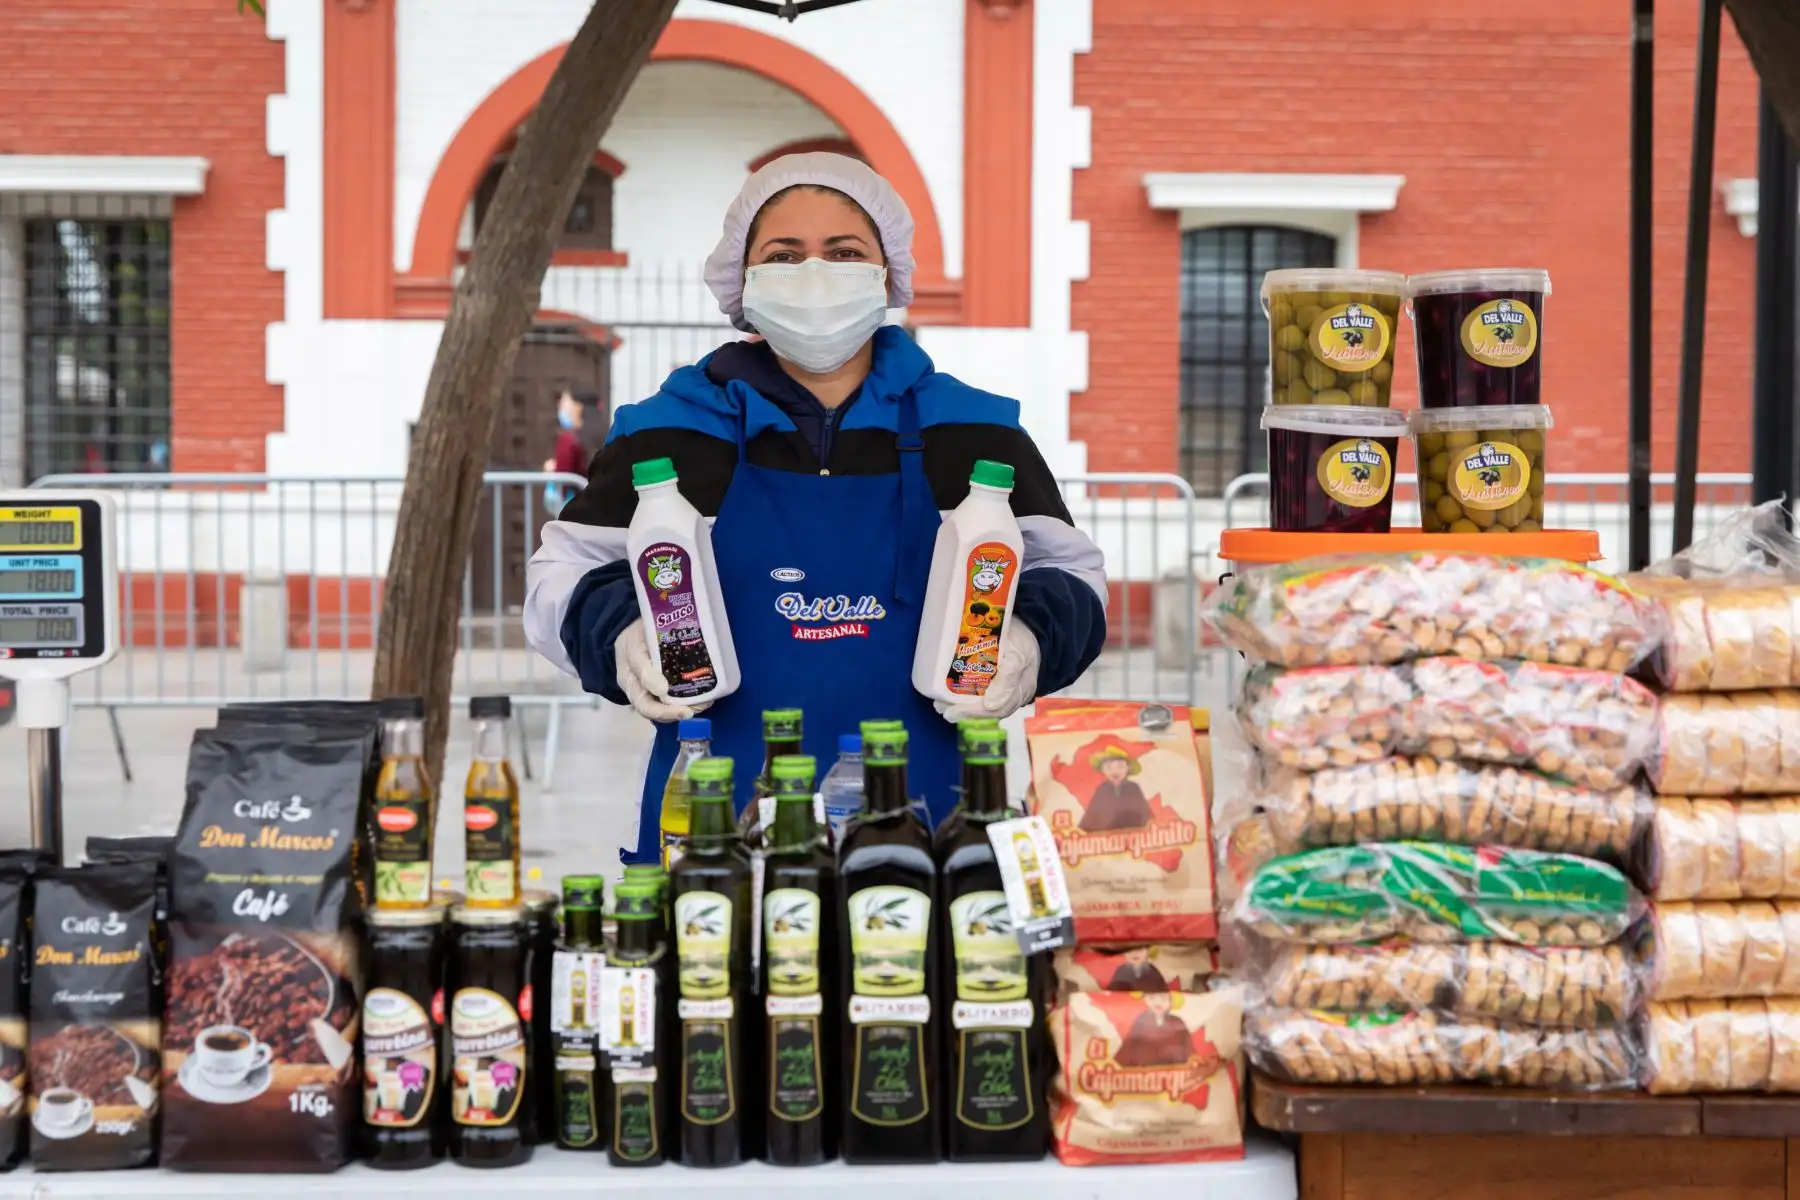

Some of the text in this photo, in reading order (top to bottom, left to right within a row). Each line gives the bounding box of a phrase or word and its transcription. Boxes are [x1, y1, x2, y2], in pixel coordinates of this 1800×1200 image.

[1332, 317, 1374, 329] DEL VALLE
[1483, 312, 1524, 324] DEL VALLE
[1342, 452, 1381, 465] DEL VALLE
[1466, 455, 1510, 470] DEL VALLE
[13, 510, 52, 518] WEIGHT
[9, 559, 60, 567] UNIT PRICE
[2, 606, 70, 616] TOTAL PRICE
[775, 592, 886, 621] Del Valle
[657, 604, 694, 628] Sauco
[794, 623, 865, 640] ARTESANAL
[233, 799, 281, 819] Café
[199, 824, 335, 851] Don Marcos
[232, 888, 289, 921] Café
[61, 916, 100, 934] Café
[35, 944, 141, 966] Don Marcos
[288, 1092, 335, 1118] 1Kg.
